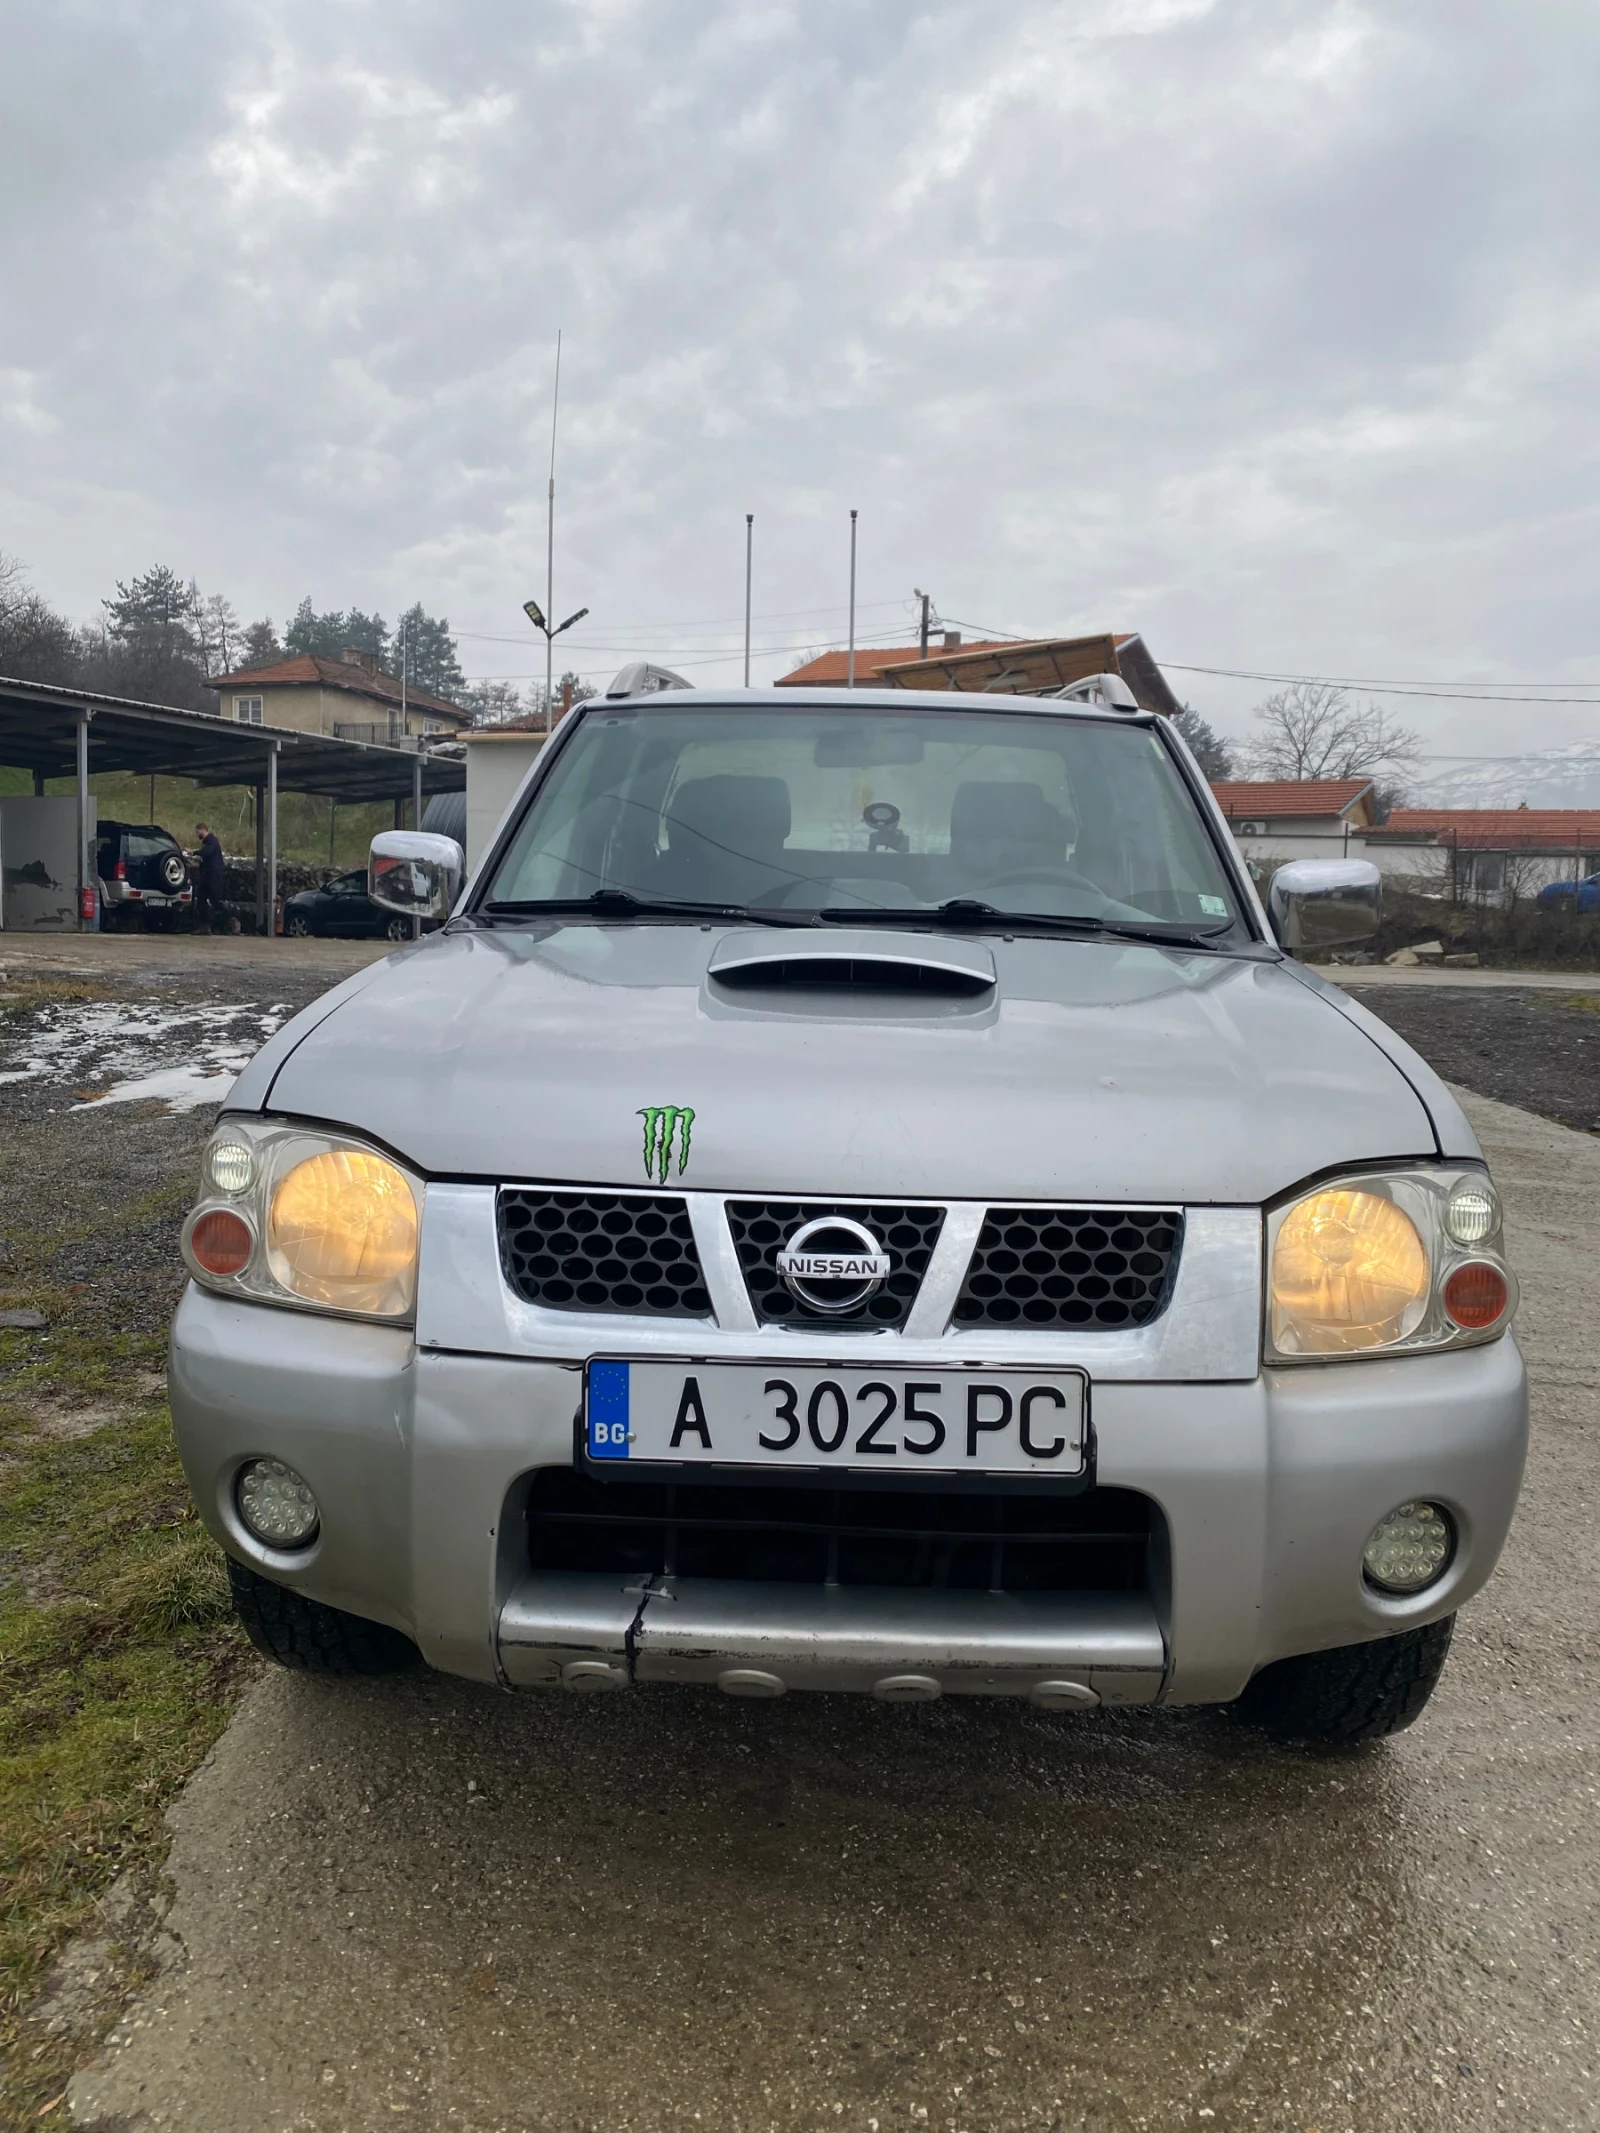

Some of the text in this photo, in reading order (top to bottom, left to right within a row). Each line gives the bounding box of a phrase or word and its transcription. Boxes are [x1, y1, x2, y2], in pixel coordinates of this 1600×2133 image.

[788, 1258, 878, 1274] NISSAN
[669, 1376, 713, 1449] A
[594, 1422, 626, 1444] BG
